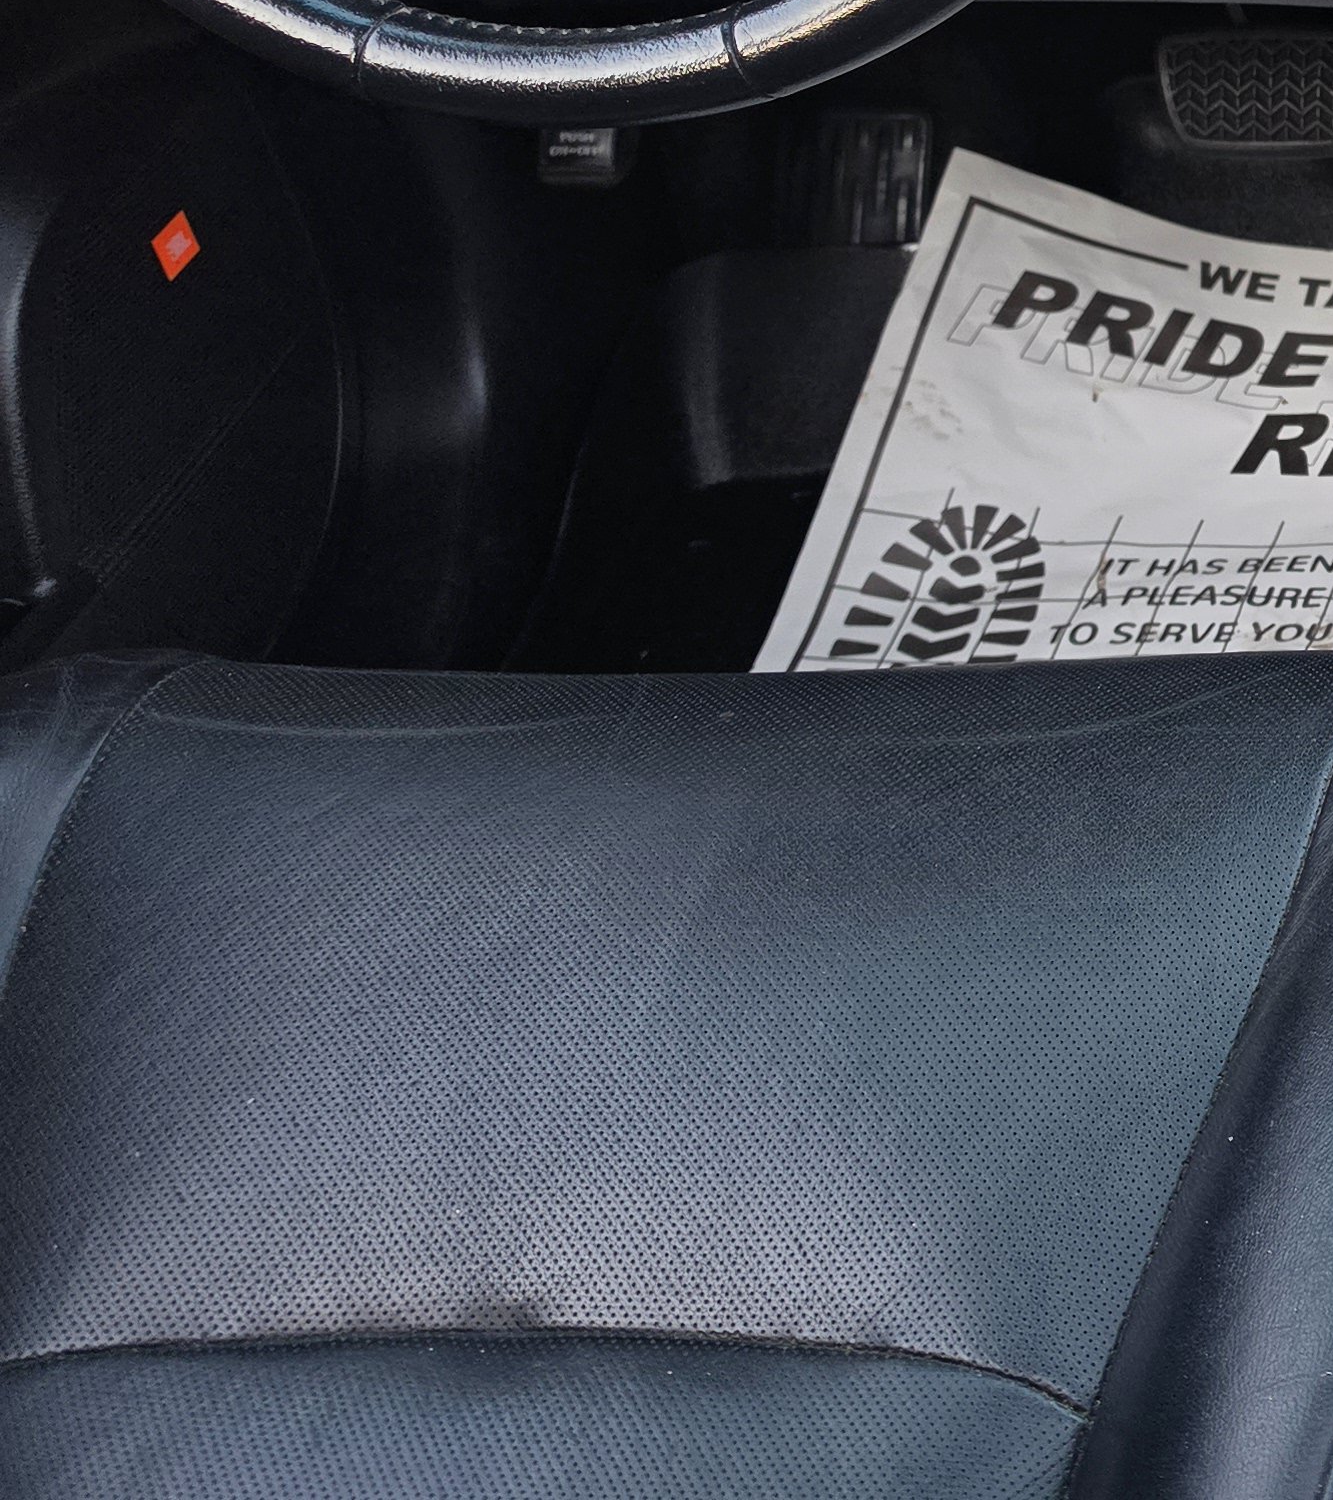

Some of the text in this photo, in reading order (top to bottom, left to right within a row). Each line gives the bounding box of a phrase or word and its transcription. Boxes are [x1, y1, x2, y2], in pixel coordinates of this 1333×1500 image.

[1198, 261, 1280, 301] WE
[1100, 558, 1140, 576] IT
[1147, 558, 1228, 577] HAS
[1081, 586, 1329, 610] A PLEASURE
[1050, 622, 1333, 646] TO SERVE YOU
